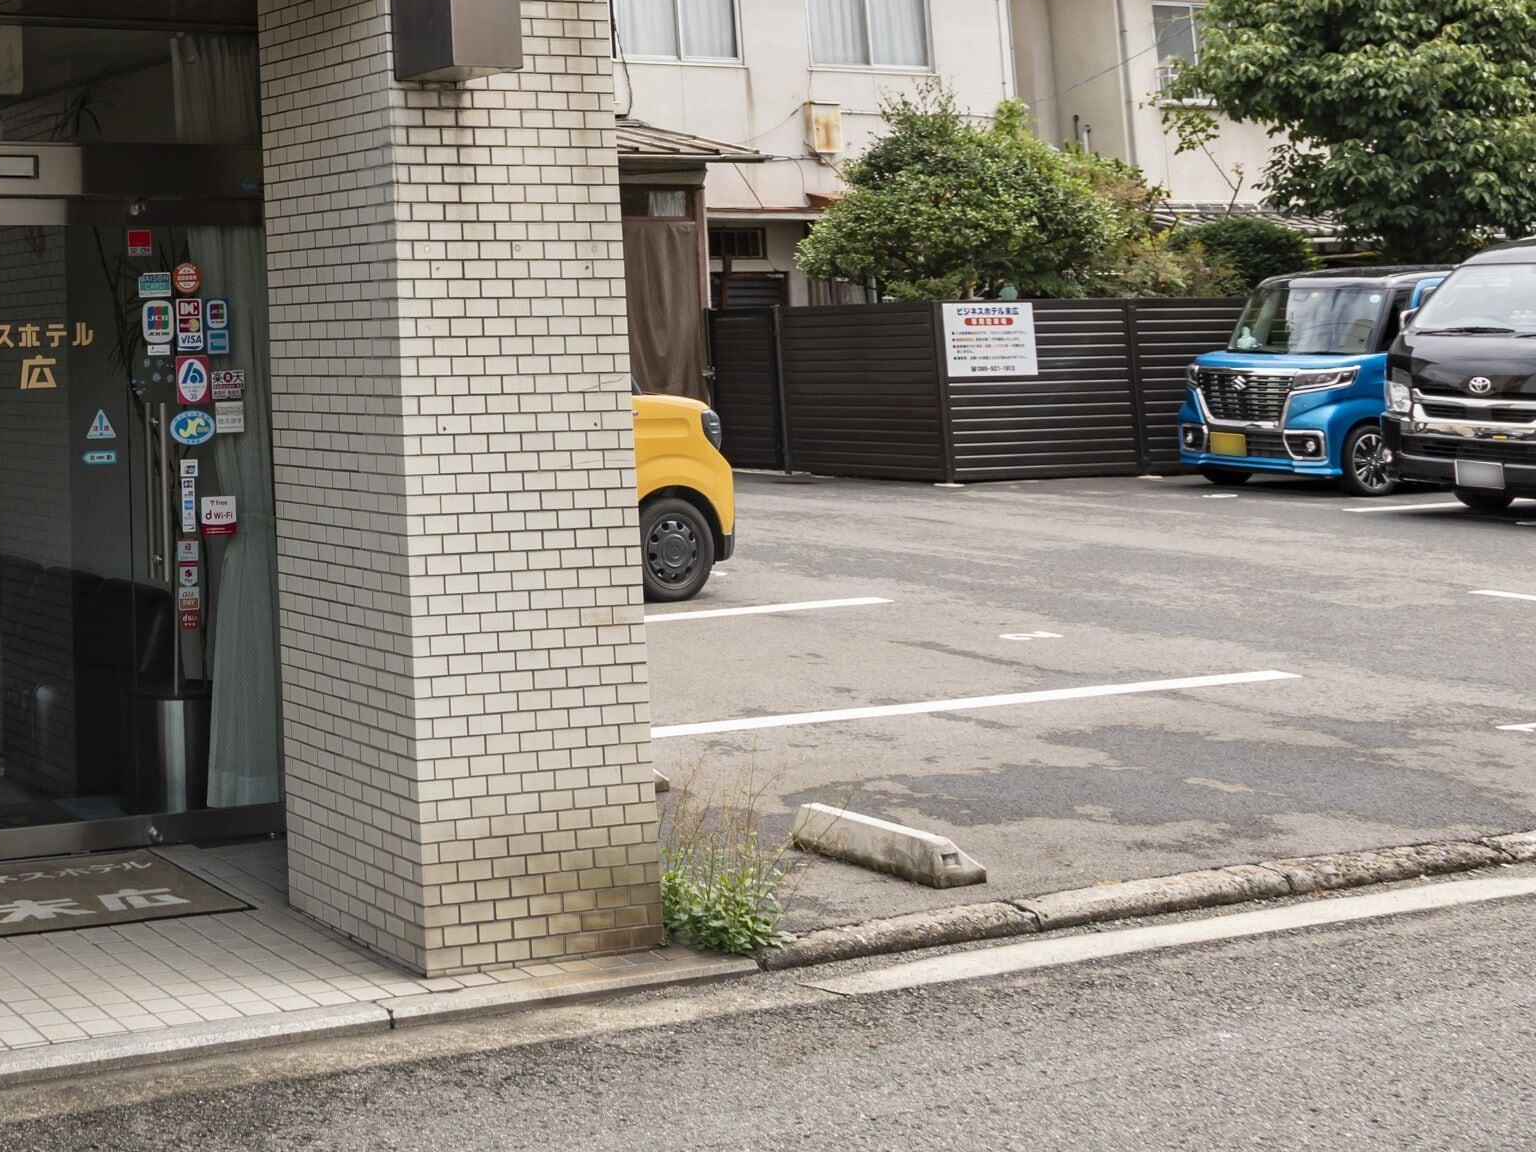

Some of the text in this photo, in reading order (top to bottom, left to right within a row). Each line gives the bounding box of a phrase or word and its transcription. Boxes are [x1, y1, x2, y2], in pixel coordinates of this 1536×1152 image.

[180, 302, 198, 315] DC
[181, 335, 202, 344] VISA
[213, 511, 233, 519] Wi-Fi
